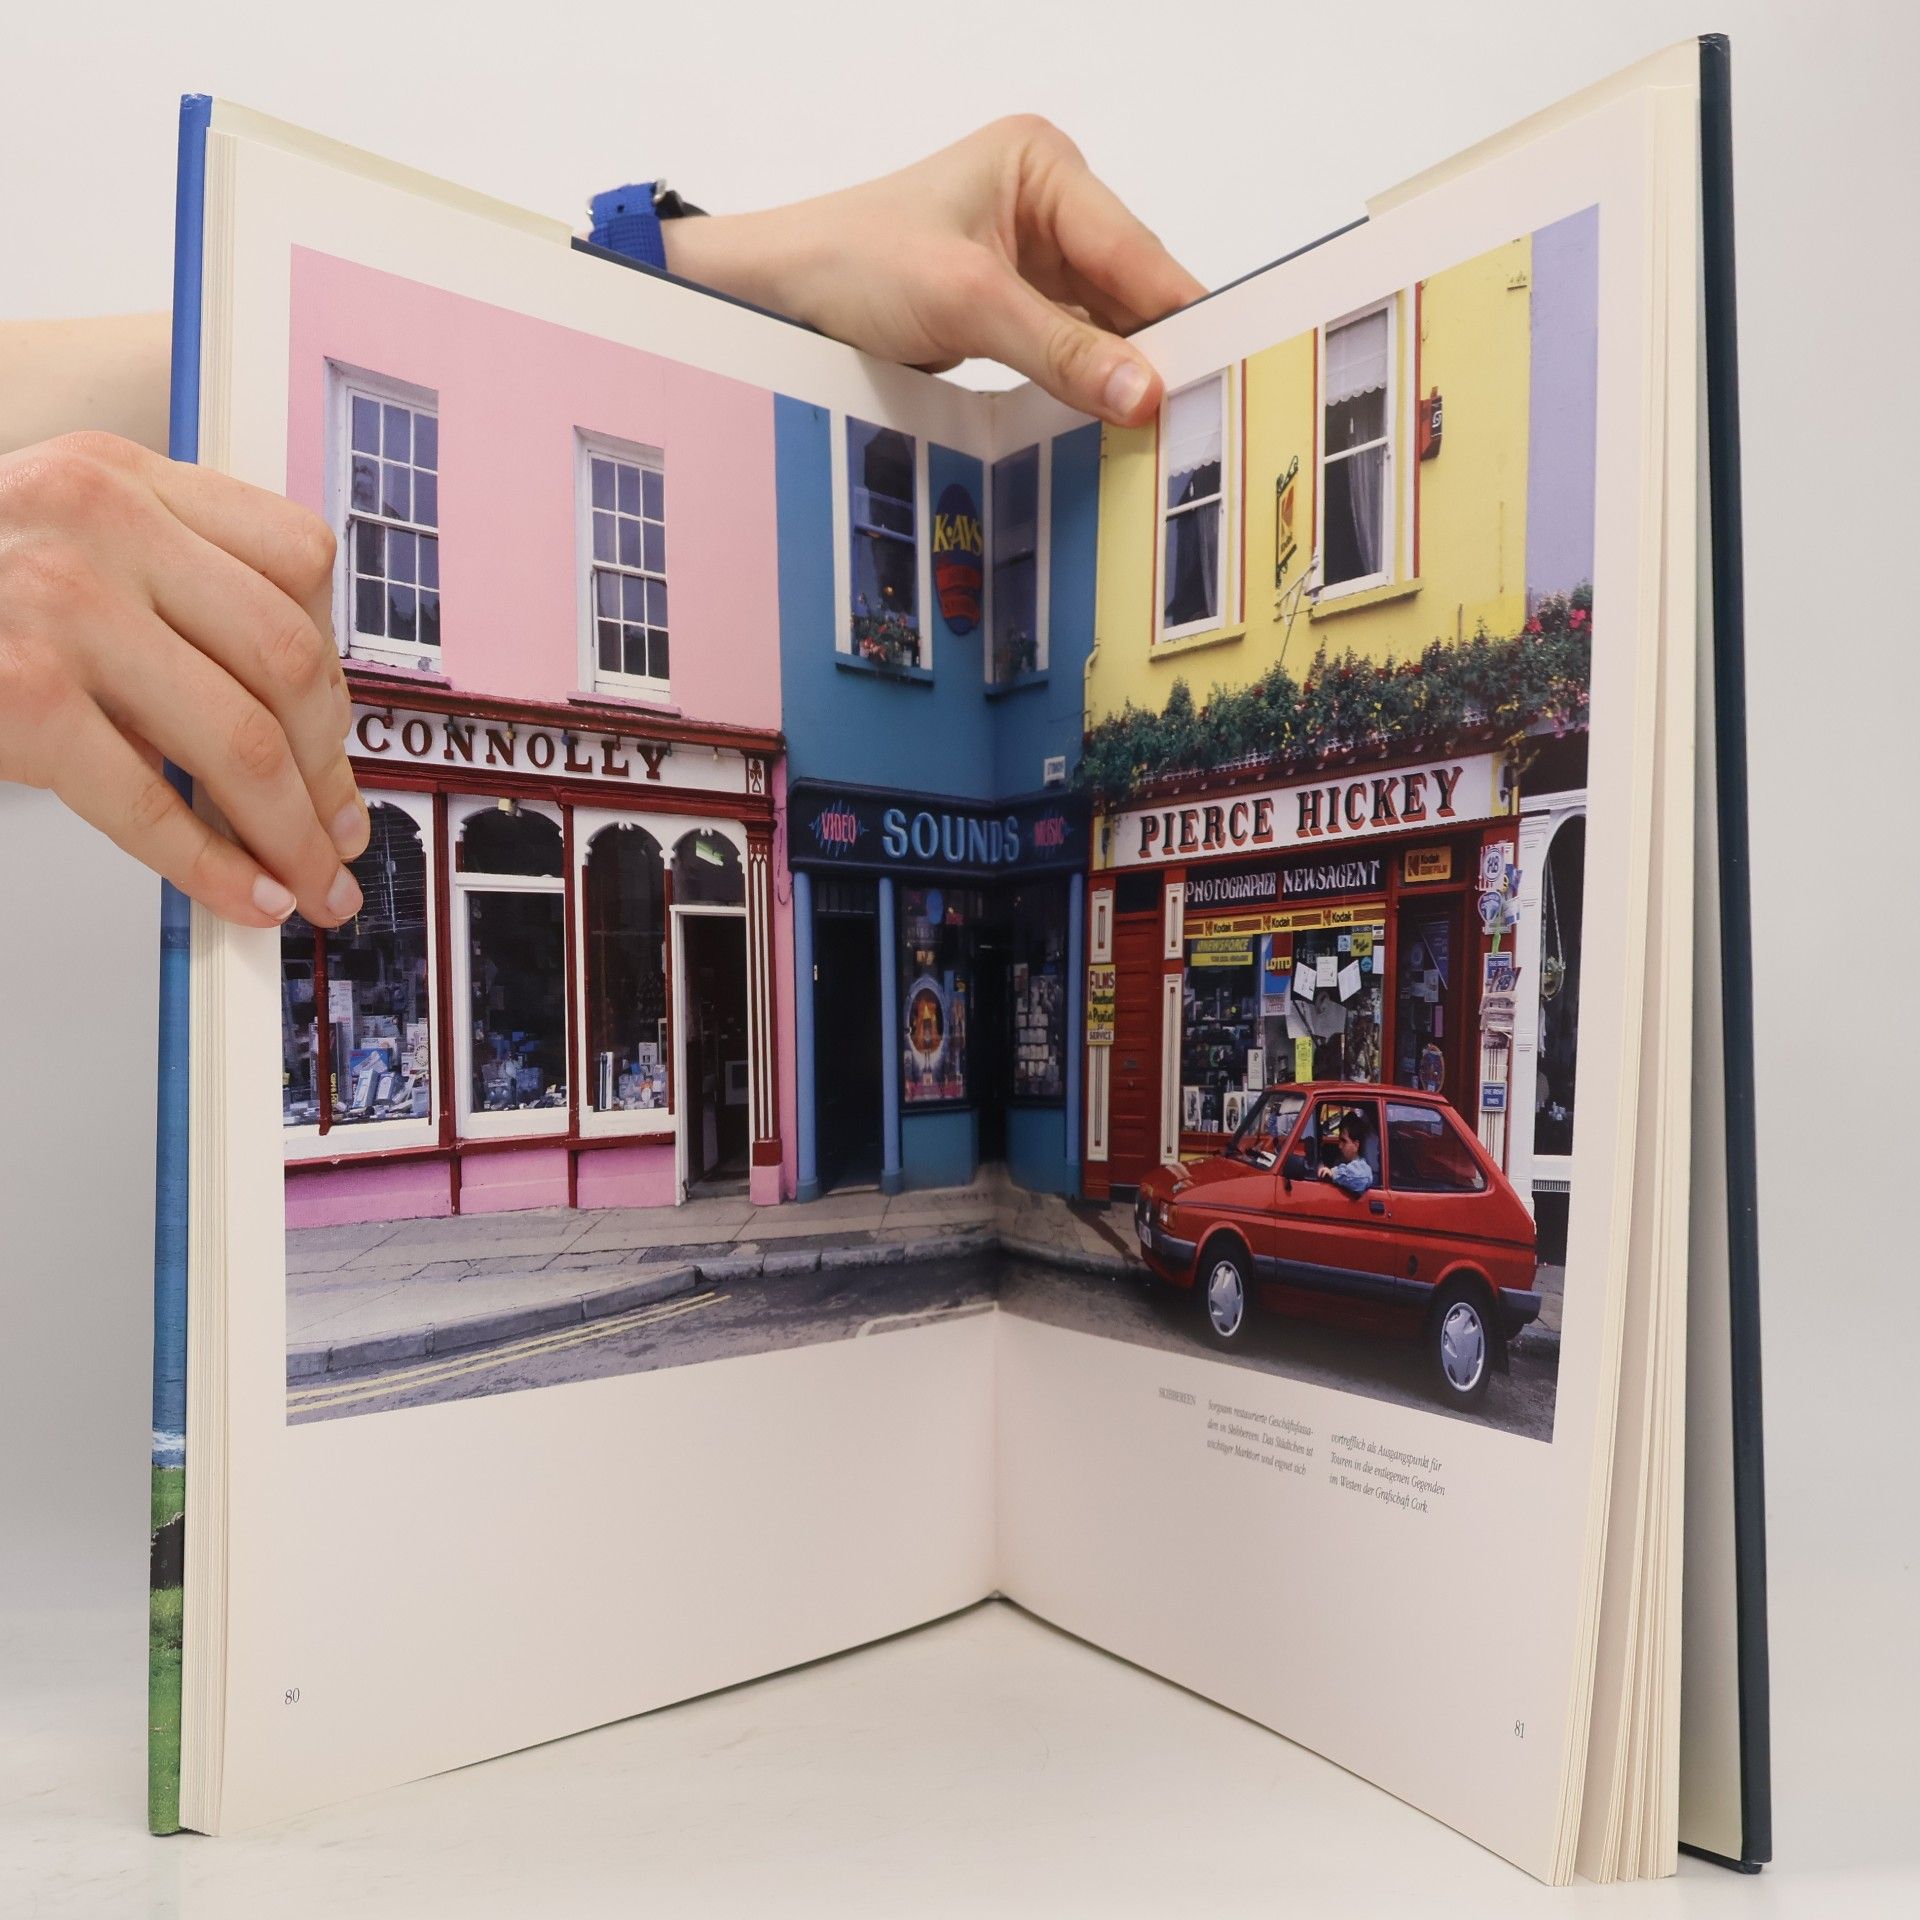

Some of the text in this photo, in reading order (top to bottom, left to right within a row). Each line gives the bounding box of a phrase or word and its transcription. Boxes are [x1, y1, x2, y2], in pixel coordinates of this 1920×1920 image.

[356, 713, 668, 780] CONNOLLY
[821, 812, 858, 844] VIDEO
[1138, 766, 1464, 858] PIERCE HICKEY
[882, 808, 1020, 864] SOUNDS
[1034, 815, 1066, 847] MUSIC
[1184, 859, 1380, 903] PHOTOGRAPHER NEWSAGENT
[1213, 911, 1353, 934] Kodak Kodak Kodak
[1265, 956, 1292, 971] LOTTO
[1089, 970, 1115, 992] FILMS
[1233, 1407, 1268, 1425] restaurierte
[1207, 1439, 1234, 1455] wichtiger
[1261, 1454, 1274, 1466] und
[1274, 1458, 1293, 1472] eignet
[1294, 1464, 1306, 1476] sich
[1262, 1432, 1274, 1446] Das
[1275, 1436, 1305, 1455] Städtchen
[1331, 1433, 1442, 1473] vortrefflich als Ausgangspunkt für
[1330, 1451, 1353, 1469] Touren
[1354, 1459, 1362, 1470] in
[1362, 1460, 1373, 1475] die
[1411, 1475, 1446, 1496] Gegenden
[1329, 1473, 1338, 1485] im
[1340, 1475, 1362, 1492] Westen
[1362, 1482, 1375, 1496] der
[1375, 1486, 1410, 1509] Grafschaft
[285, 1687, 300, 1705] 80
[1514, 1720, 1525, 1738] 81
